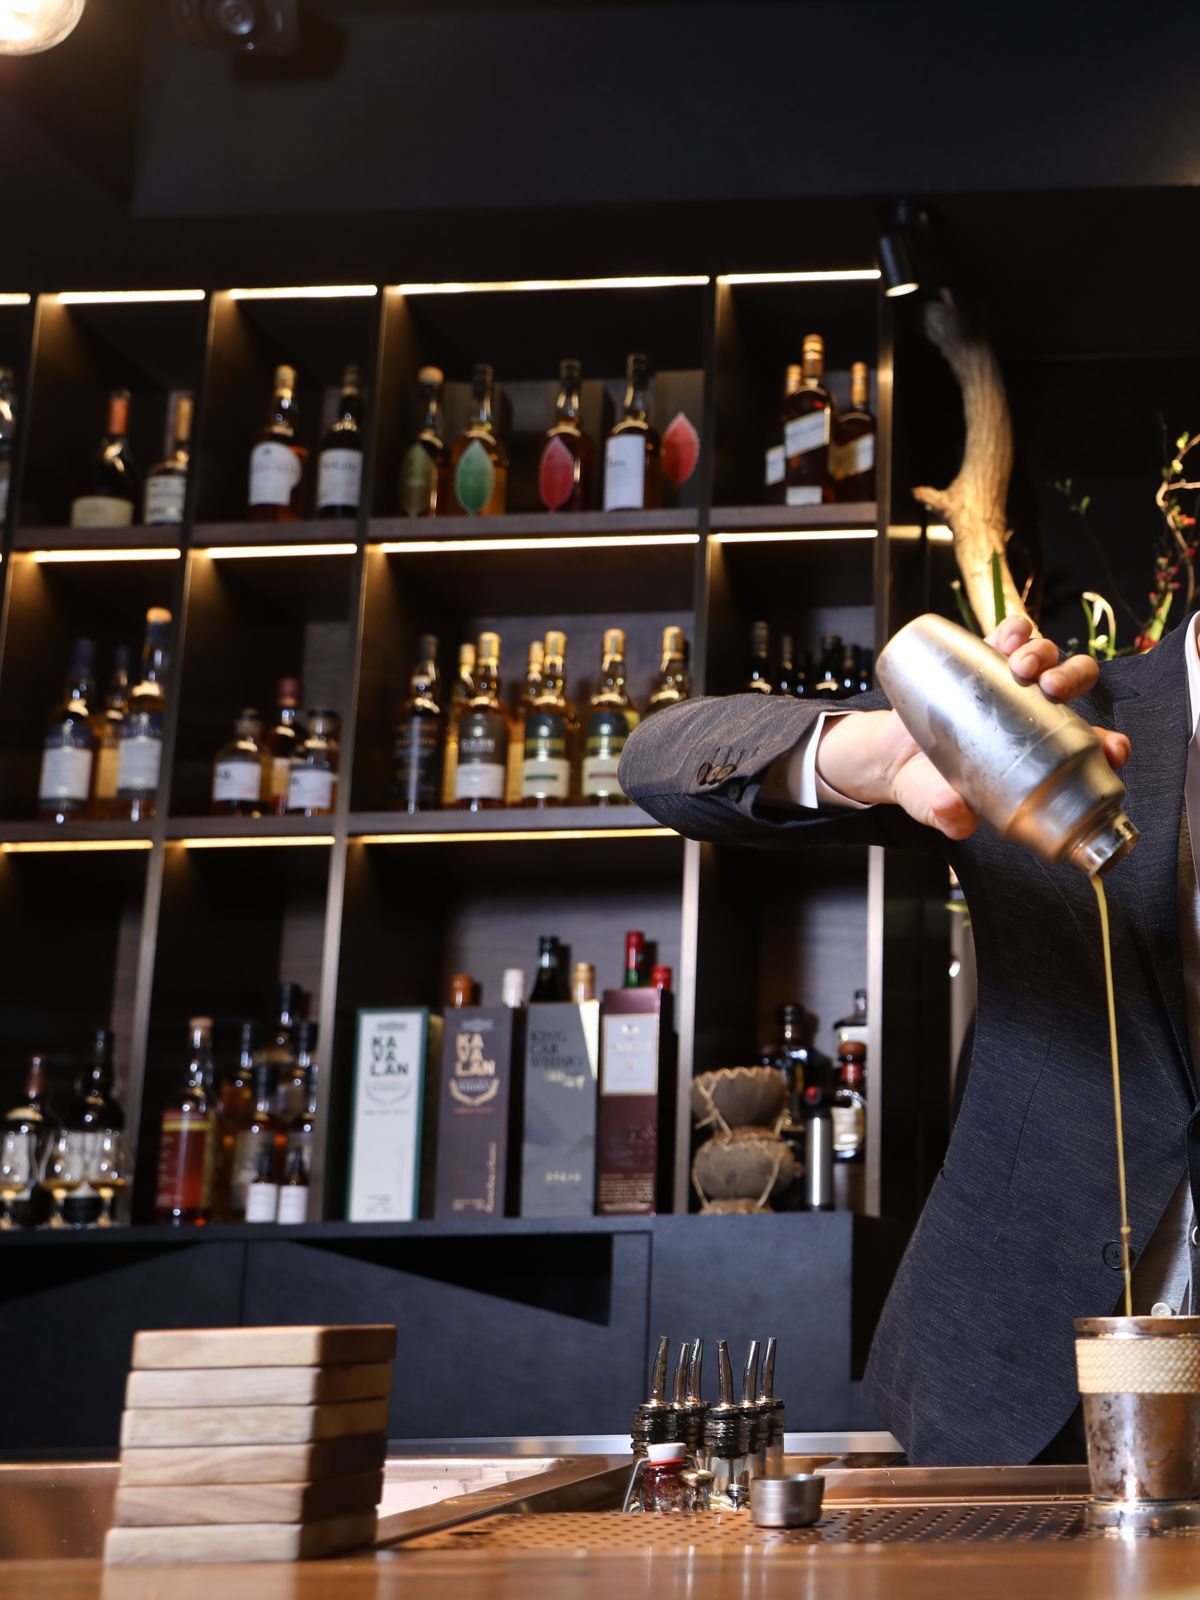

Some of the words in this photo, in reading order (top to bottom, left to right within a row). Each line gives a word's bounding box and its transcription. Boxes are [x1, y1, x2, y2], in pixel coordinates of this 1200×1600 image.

[371, 1035, 397, 1048] KA
[371, 1048, 396, 1062] VA
[369, 1063, 409, 1077] LAN
[455, 1060, 496, 1077] LAN
